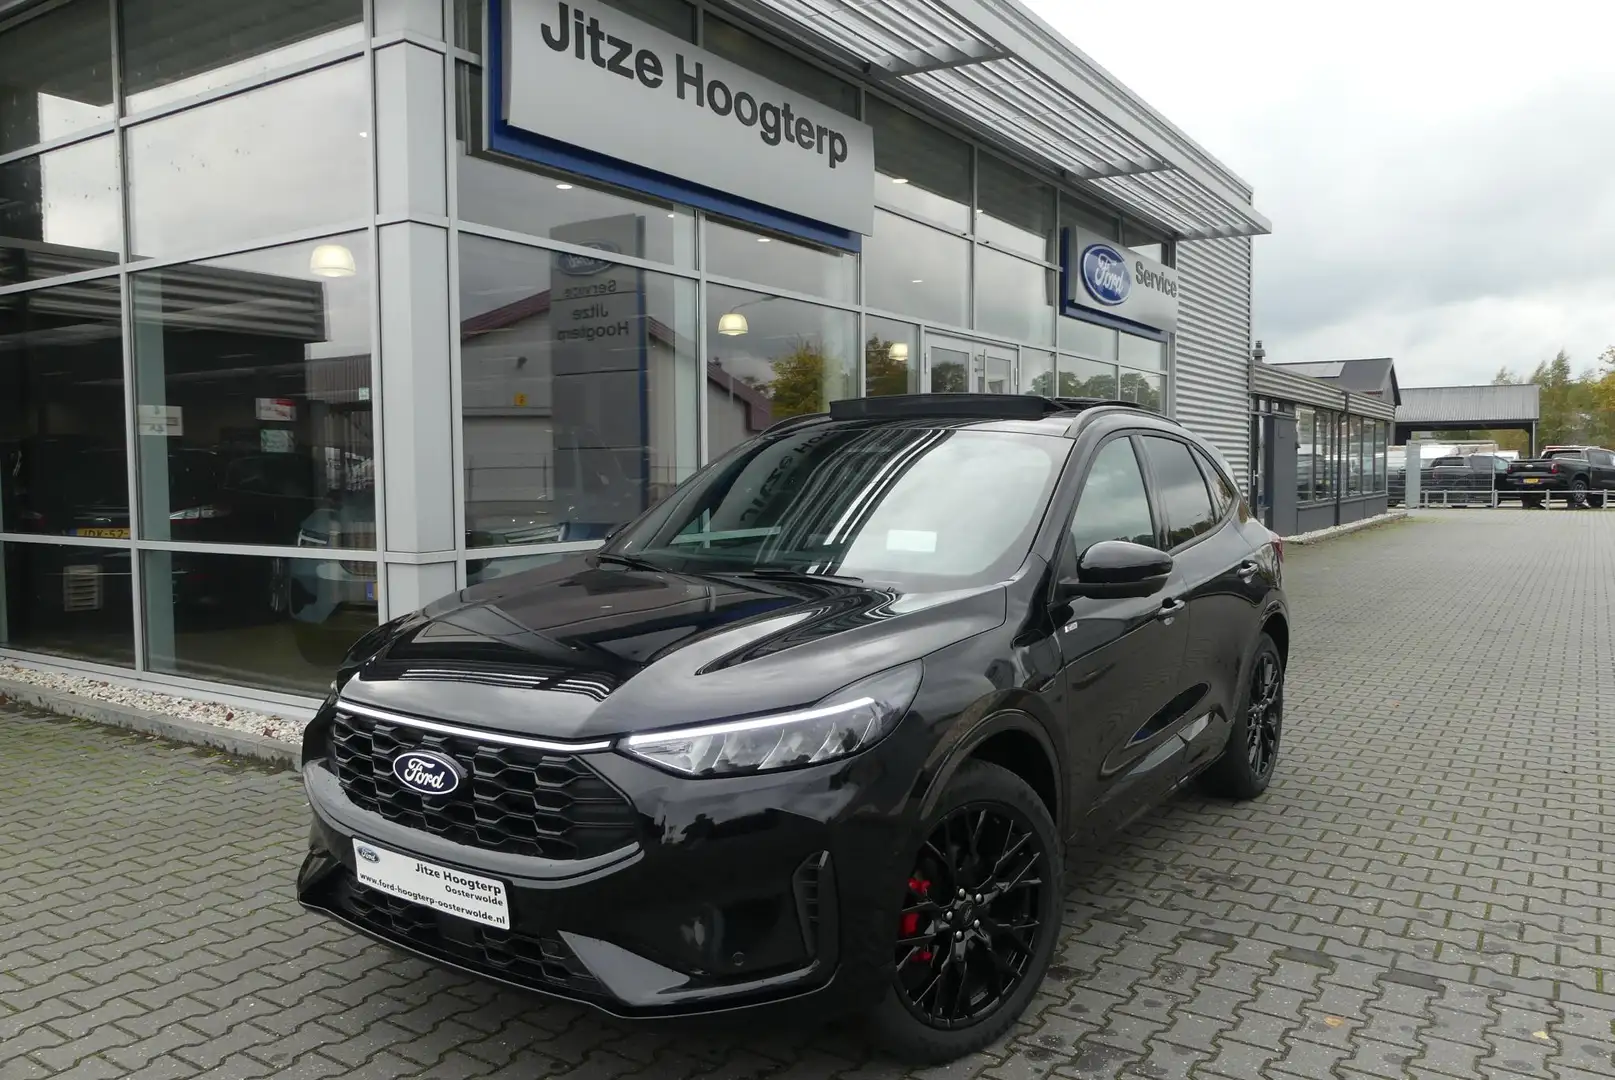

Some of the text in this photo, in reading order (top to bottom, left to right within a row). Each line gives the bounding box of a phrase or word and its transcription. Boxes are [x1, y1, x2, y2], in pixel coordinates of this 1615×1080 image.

[540, 2, 848, 168] Jitze Hoogterp
[1094, 253, 1178, 298] Ford Service
[404, 757, 446, 789] Ford
[415, 863, 502, 895] Jitze Hoogterp
[445, 885, 504, 907] Oosterwolde
[359, 872, 506, 925] www.ford-hoogterp-oosterwolde.nl
